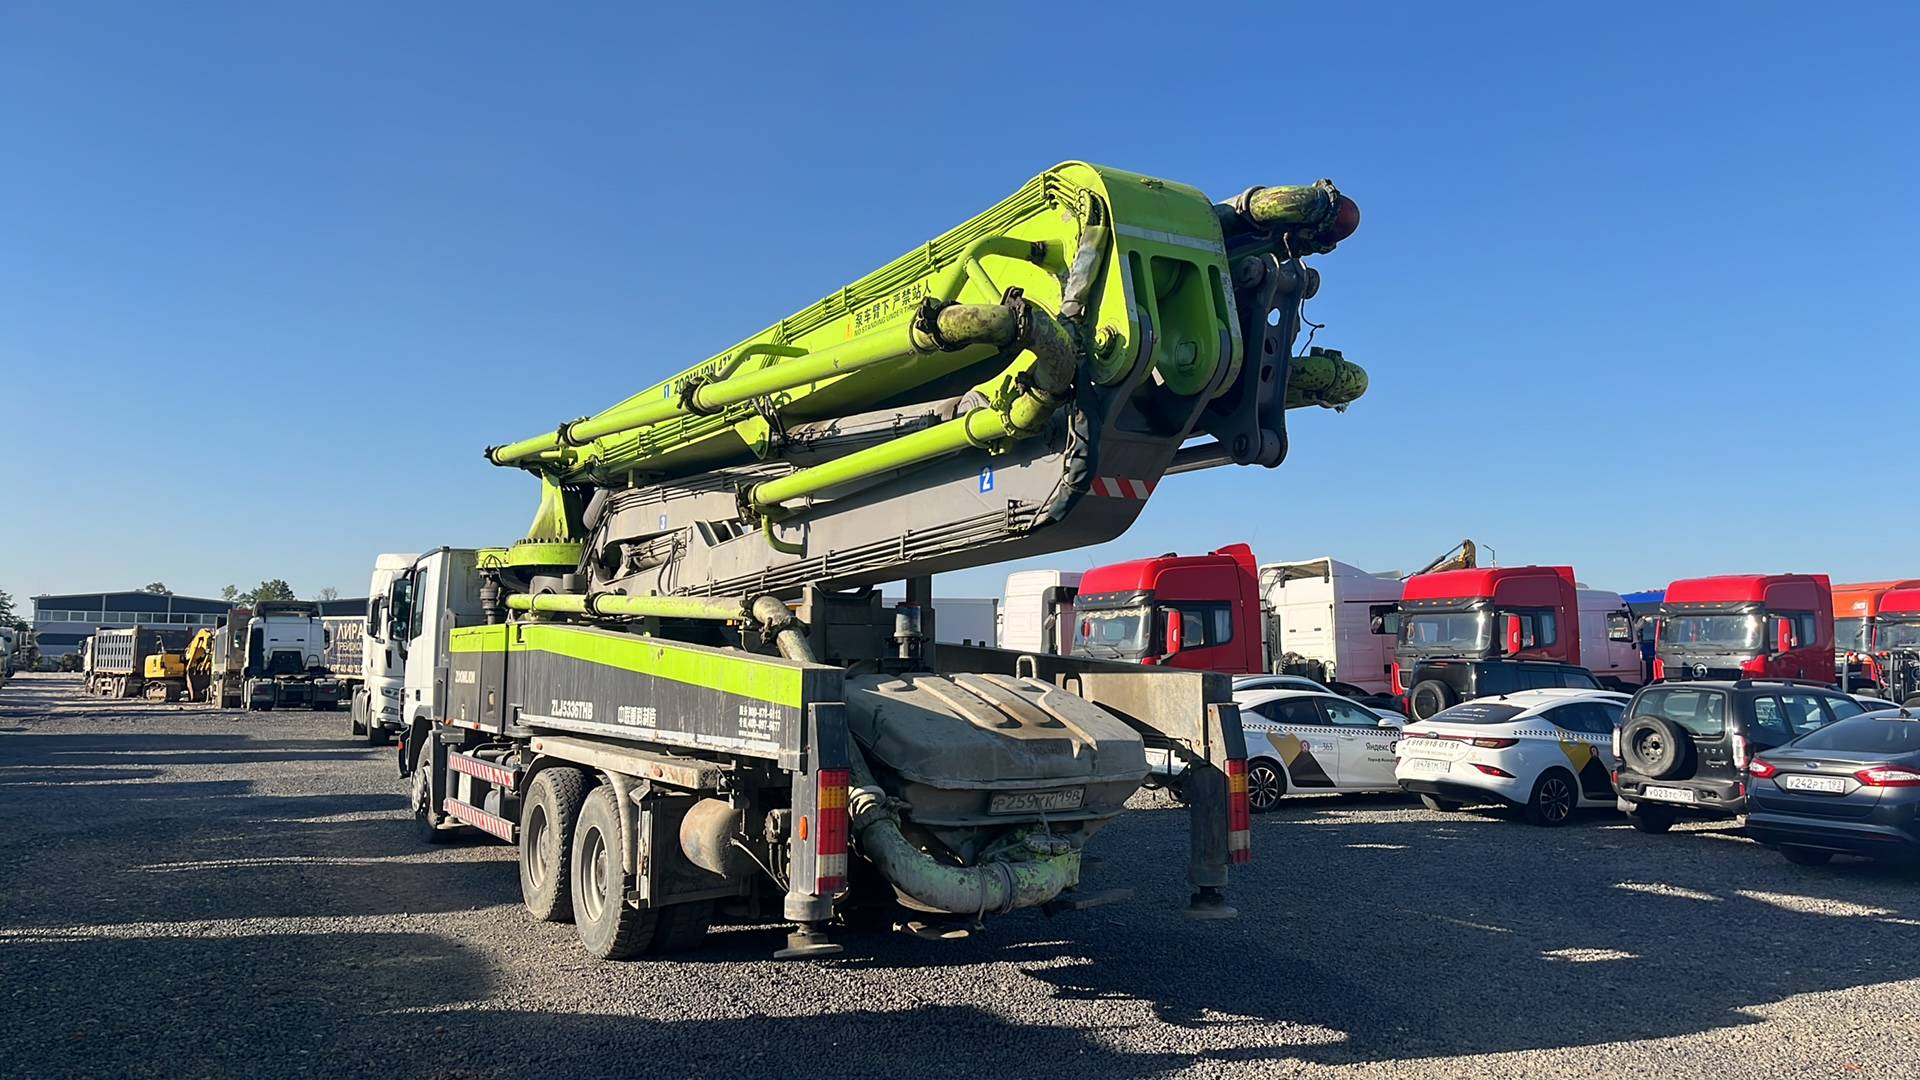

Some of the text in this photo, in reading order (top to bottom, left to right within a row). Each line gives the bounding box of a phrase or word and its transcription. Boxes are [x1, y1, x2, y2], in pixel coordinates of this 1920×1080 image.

[983, 467, 990, 489] 2
[336, 623, 364, 640] ЛИРА
[1365, 742, 1389, 752] Яндекс
